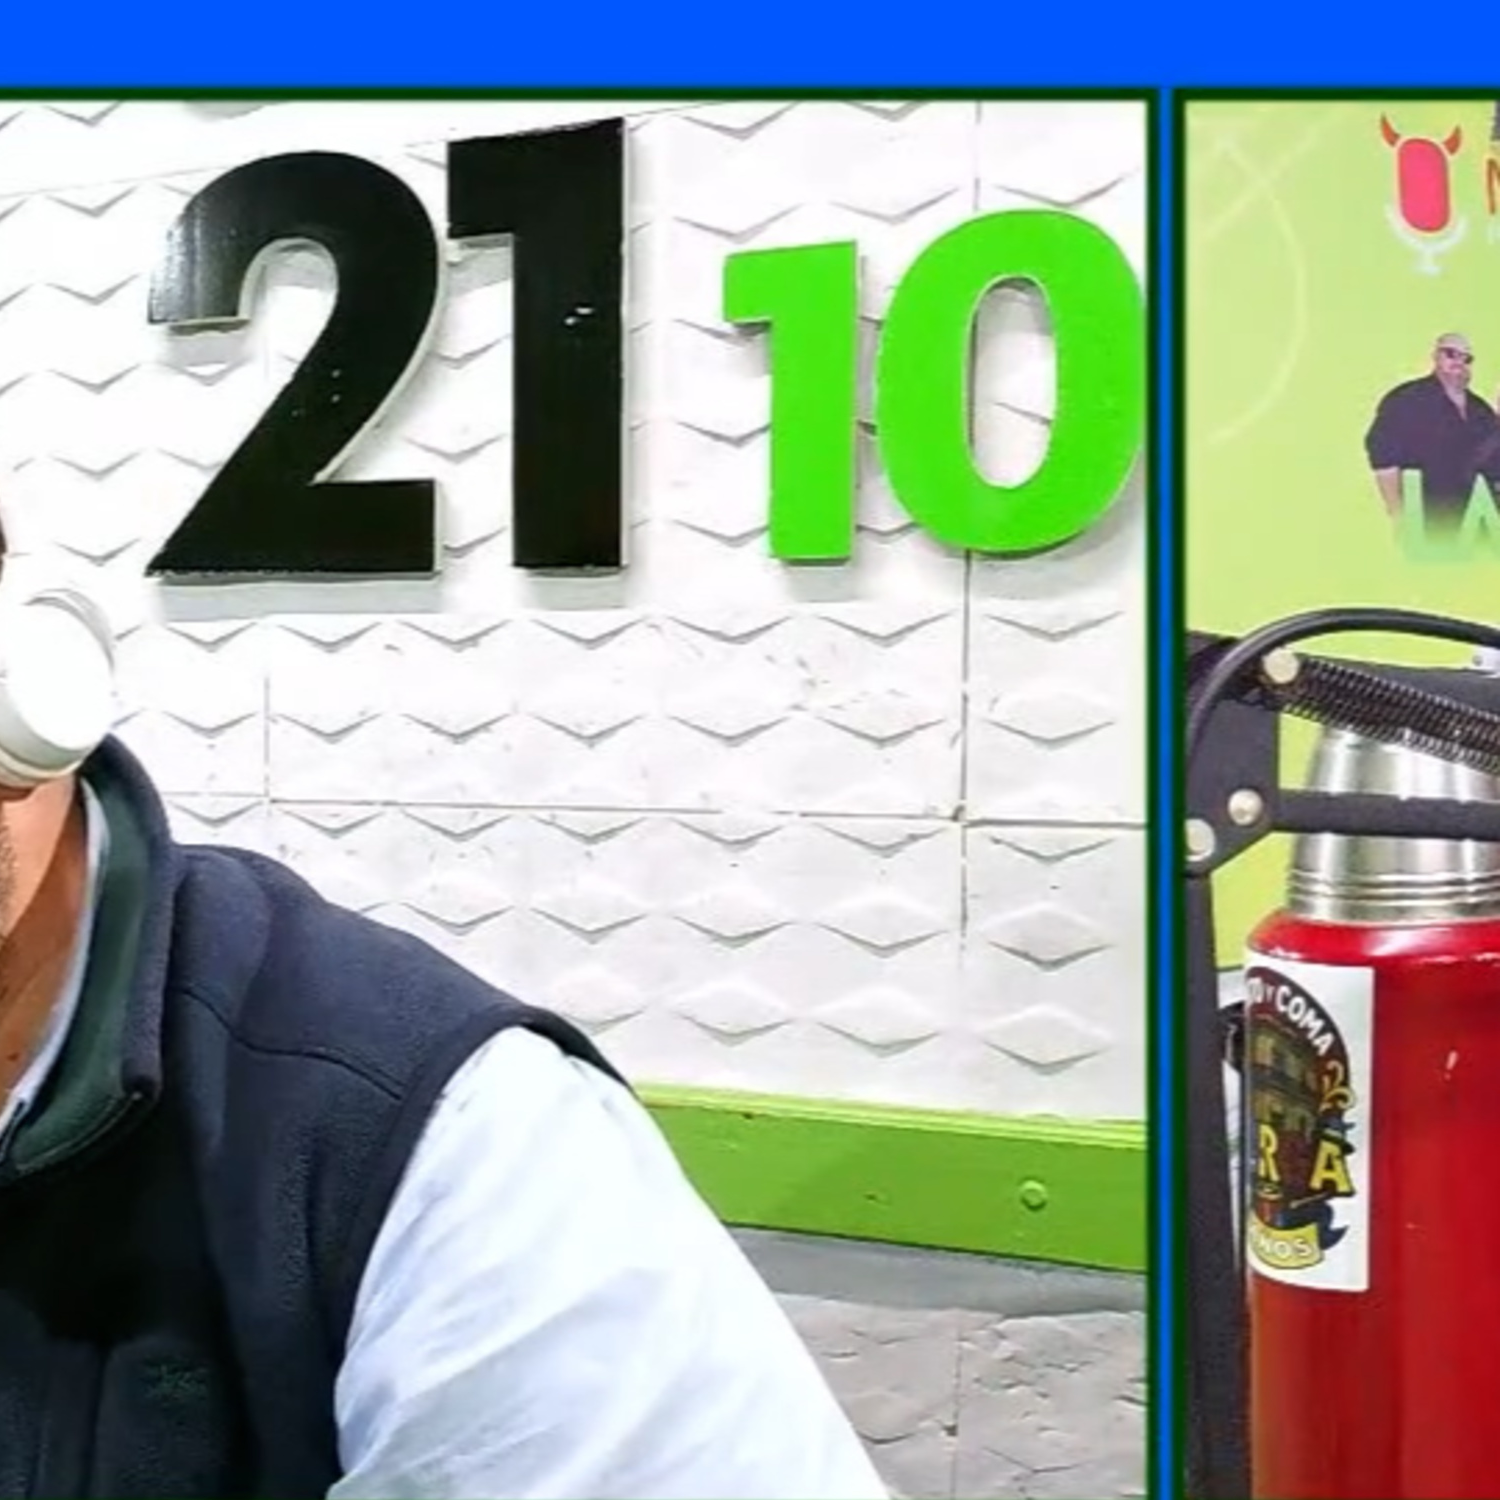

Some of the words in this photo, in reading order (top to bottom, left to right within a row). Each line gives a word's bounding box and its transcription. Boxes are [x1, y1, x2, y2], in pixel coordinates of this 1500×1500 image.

[145, 115, 627, 578] 21
[722, 208, 1146, 564] 10
[1276, 985, 1335, 1057] COMA
